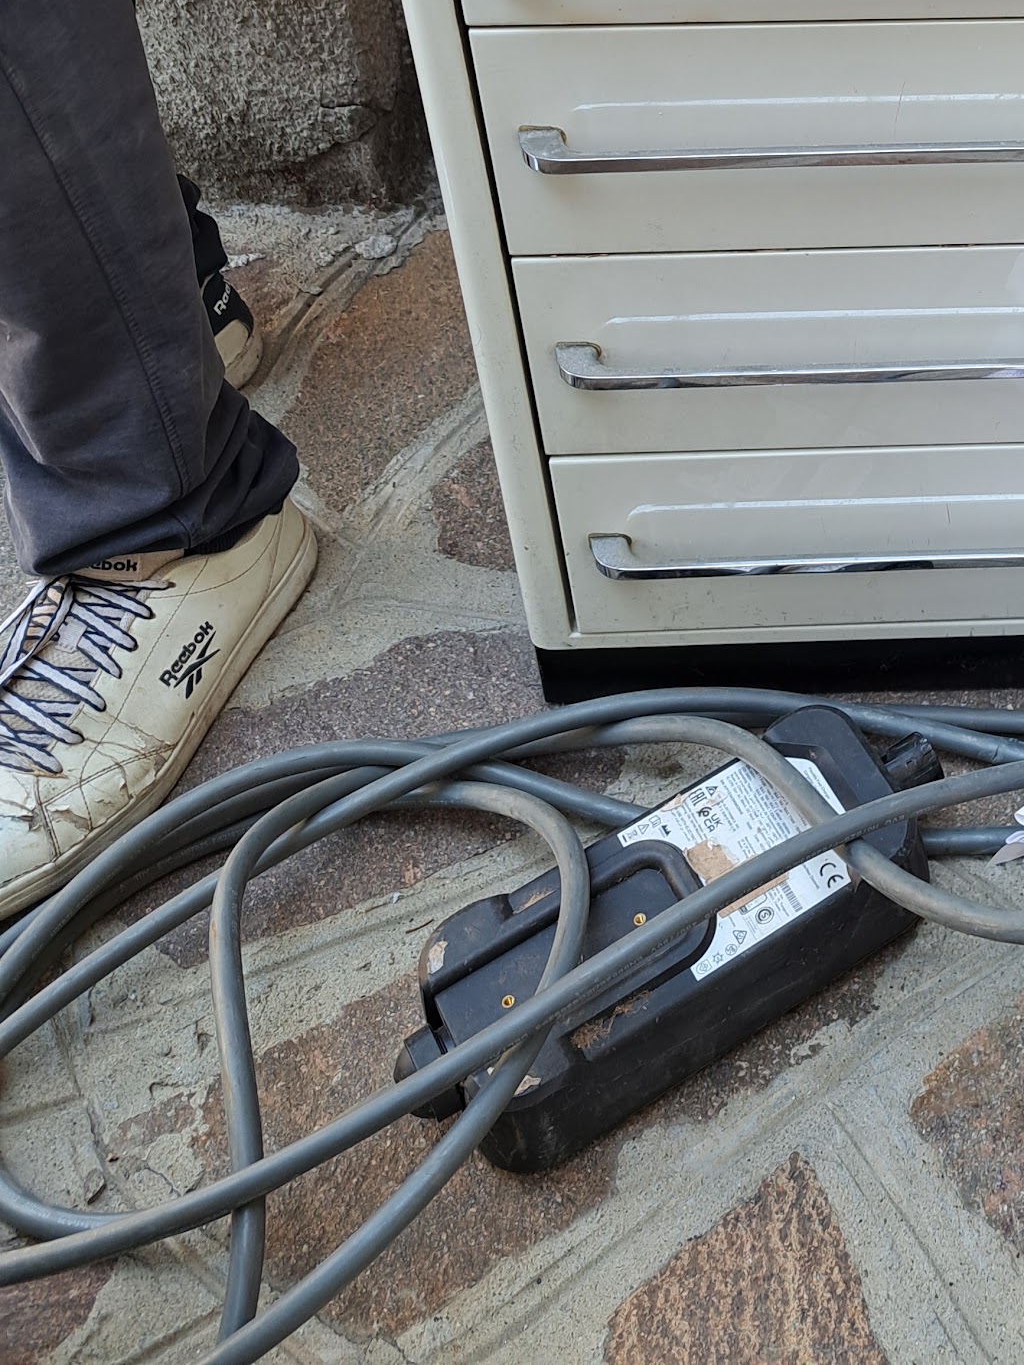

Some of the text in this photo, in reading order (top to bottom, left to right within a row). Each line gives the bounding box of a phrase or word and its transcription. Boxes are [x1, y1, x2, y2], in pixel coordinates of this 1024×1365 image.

[158, 621, 215, 687] Reebok
[703, 818, 715, 832] CA
[711, 813, 723, 828] UK
[819, 862, 844, 888] CE
